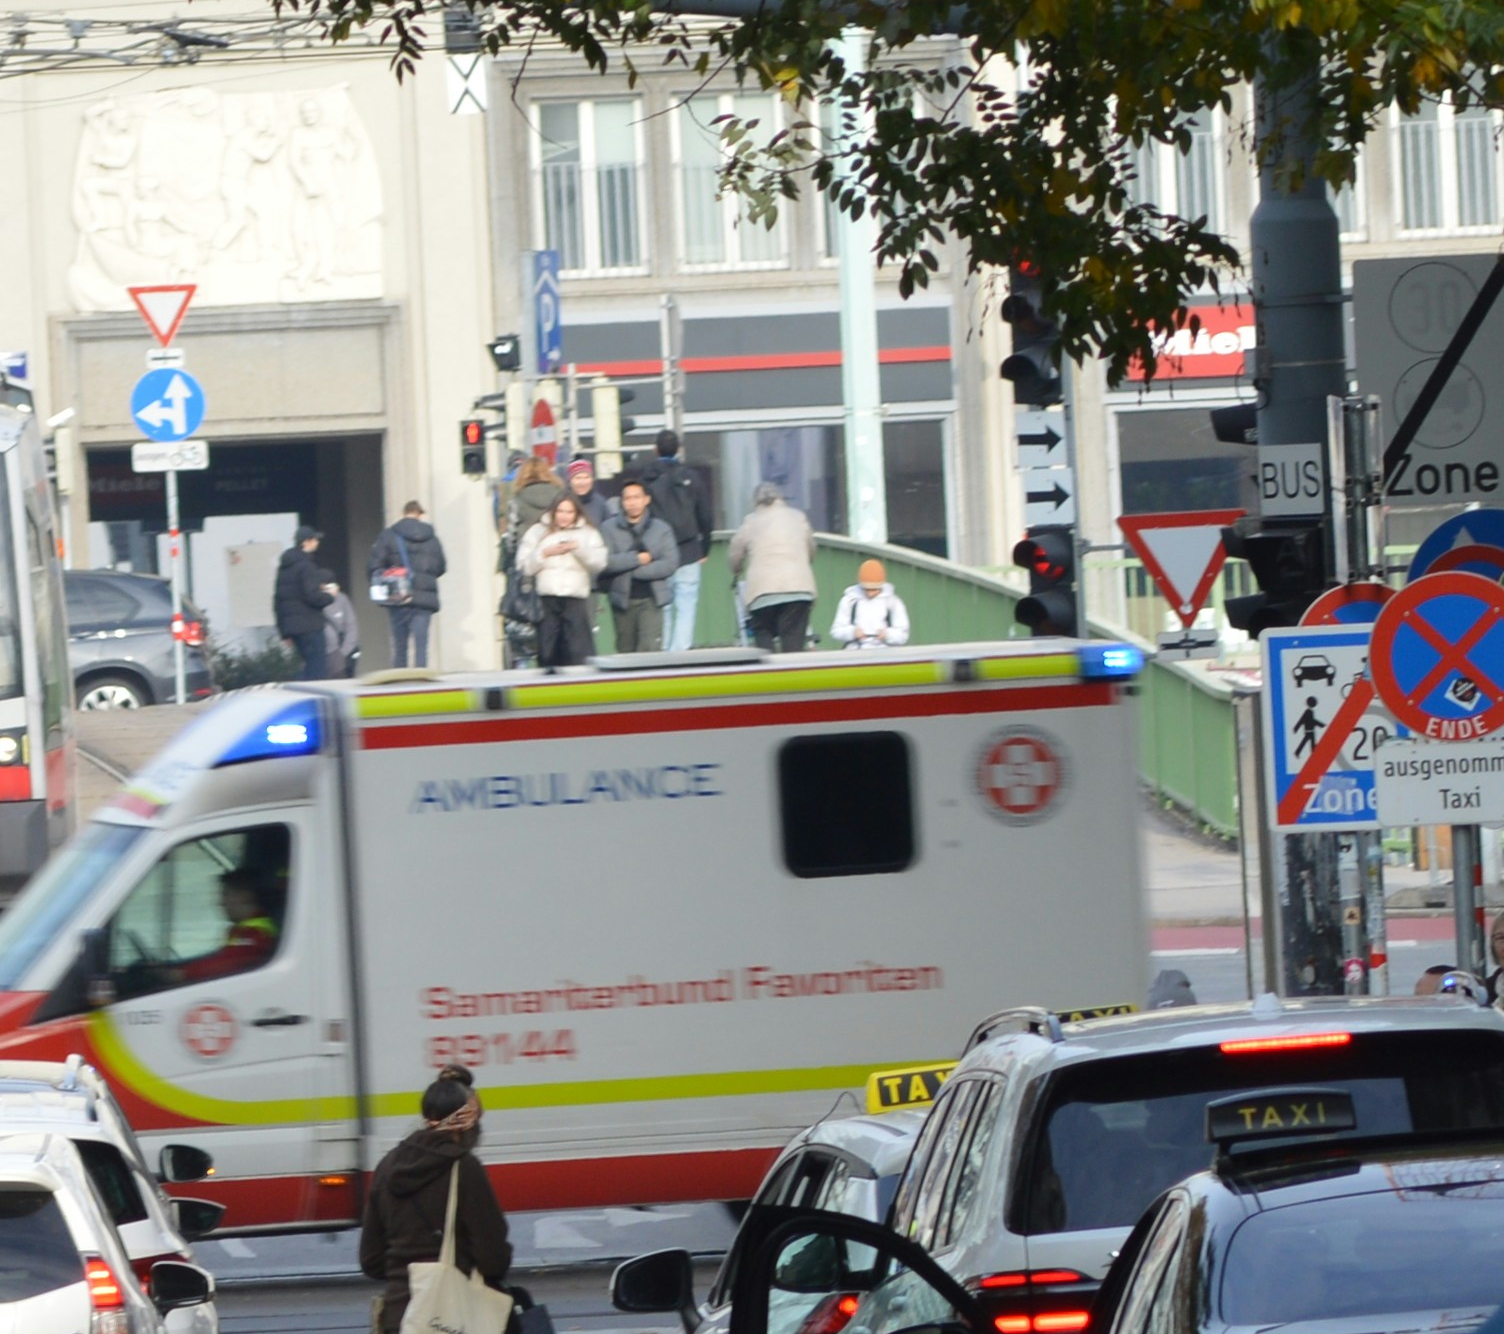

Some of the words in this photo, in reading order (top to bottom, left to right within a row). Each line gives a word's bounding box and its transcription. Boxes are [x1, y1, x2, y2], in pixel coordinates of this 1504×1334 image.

[1150, 325, 1256, 357] Miel
[1261, 460, 1321, 499] BUS
[1387, 454, 1500, 497] Zone
[1425, 714, 1489, 740] ENDE
[409, 764, 723, 813] AMBULANCE
[1439, 786, 1482, 810] Taxi
[420, 969, 735, 1019] Samariterbund
[743, 960, 944, 1001] Favoriten
[1238, 1103, 1328, 1130] TAXI
